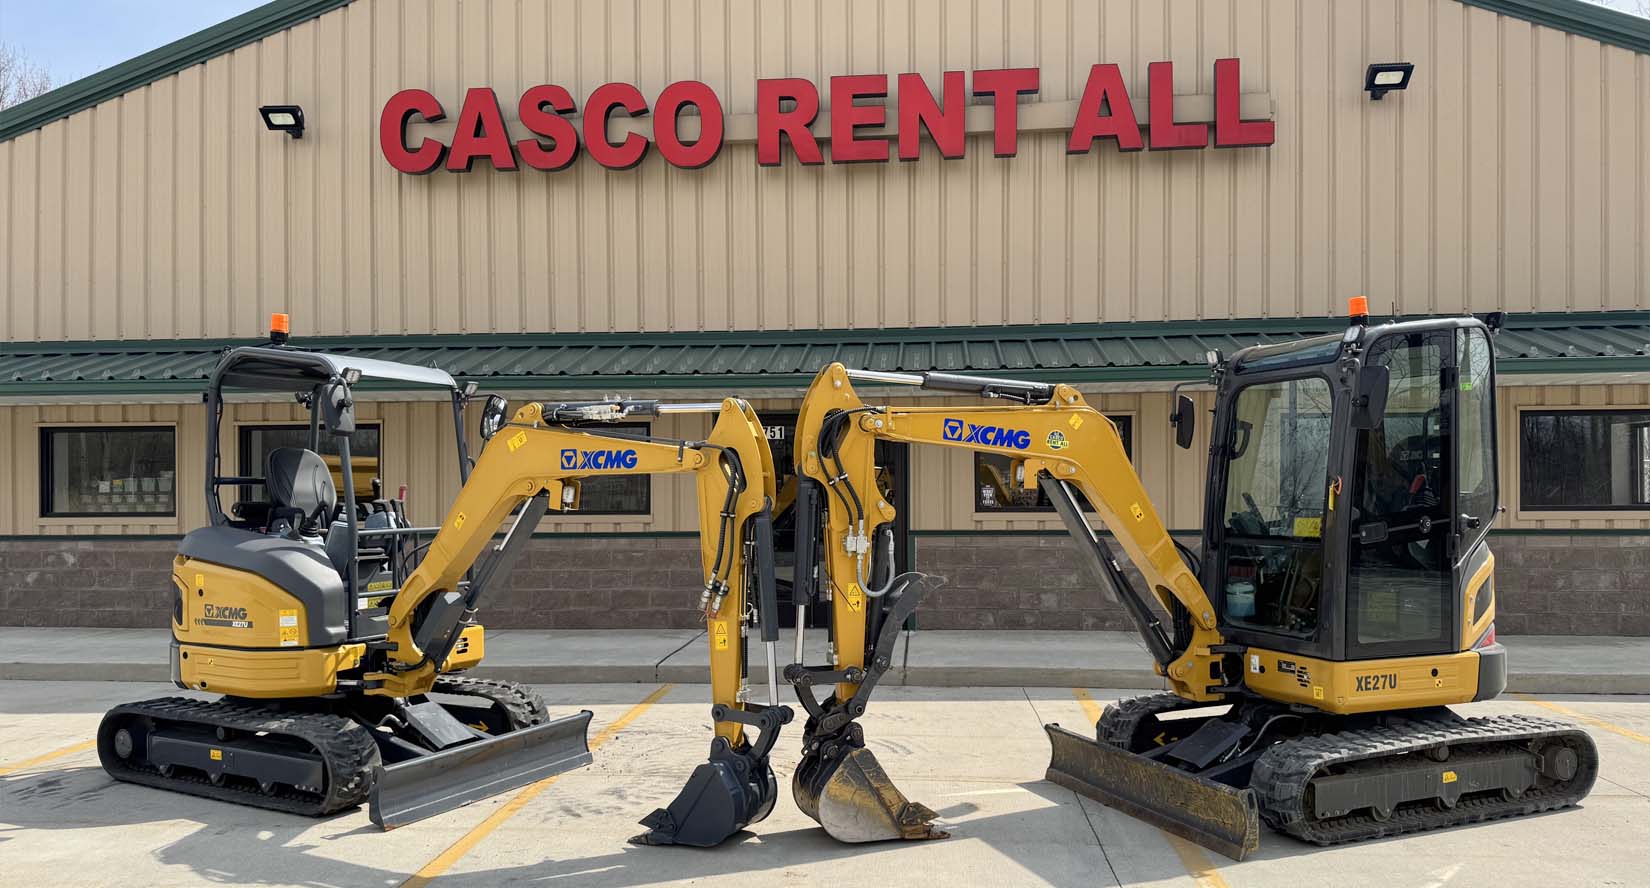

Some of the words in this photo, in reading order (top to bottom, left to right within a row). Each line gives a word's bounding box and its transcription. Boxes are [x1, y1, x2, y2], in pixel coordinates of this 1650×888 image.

[380, 80, 725, 175] CASCO
[757, 68, 1040, 167] RENT
[1066, 58, 1275, 155] ALL
[964, 424, 1031, 450] XCMG
[578, 449, 638, 470] XCMG
[214, 606, 248, 620] XCMG
[1356, 673, 1396, 692] XE27U
